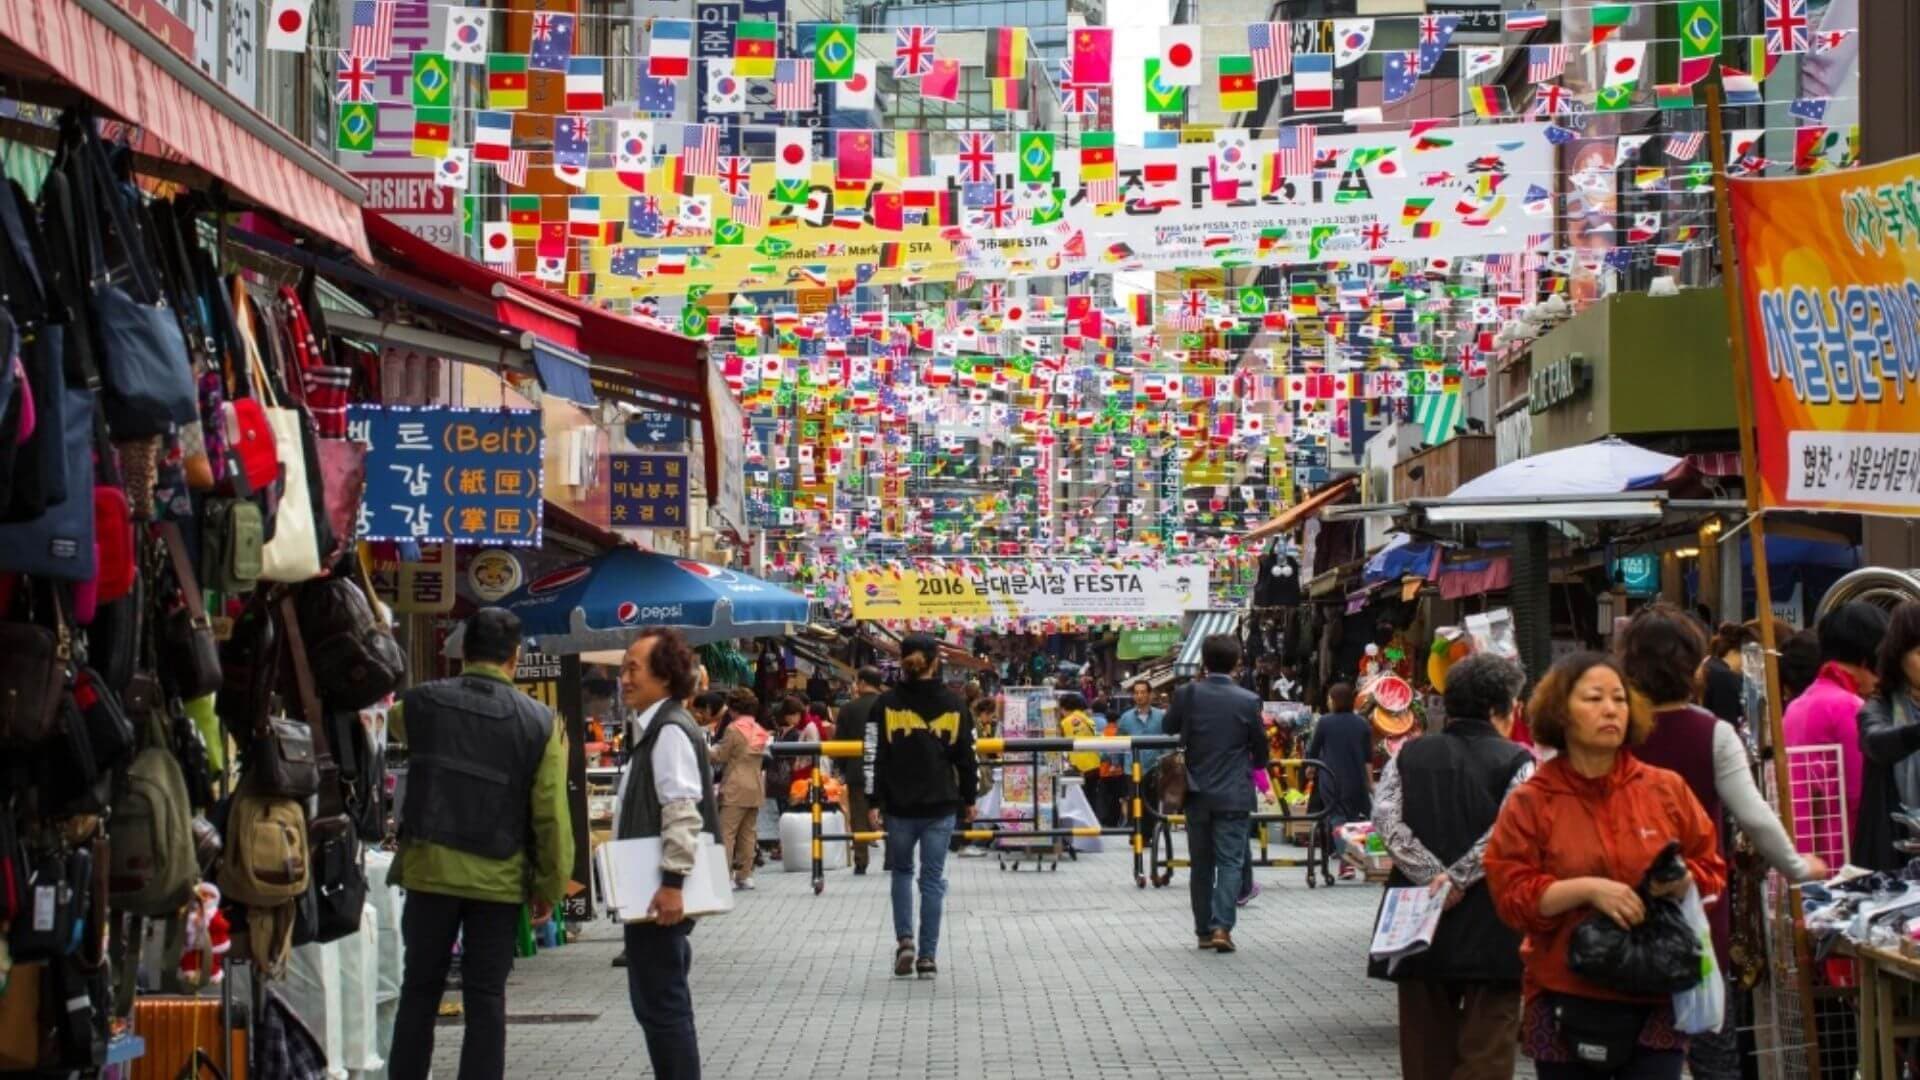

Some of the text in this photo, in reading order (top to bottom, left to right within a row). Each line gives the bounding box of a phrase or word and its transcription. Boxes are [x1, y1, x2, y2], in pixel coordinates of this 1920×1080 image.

[363, 177, 444, 209] ERSHEY'S
[443, 424, 537, 455] (Belt)
[1803, 445, 1833, 488] 협찬
[916, 577, 965, 596] 2016
[971, 574, 1066, 596] 남대문시장
[1074, 574, 1144, 594] FESTA
[641, 603, 682, 620] pepsi
